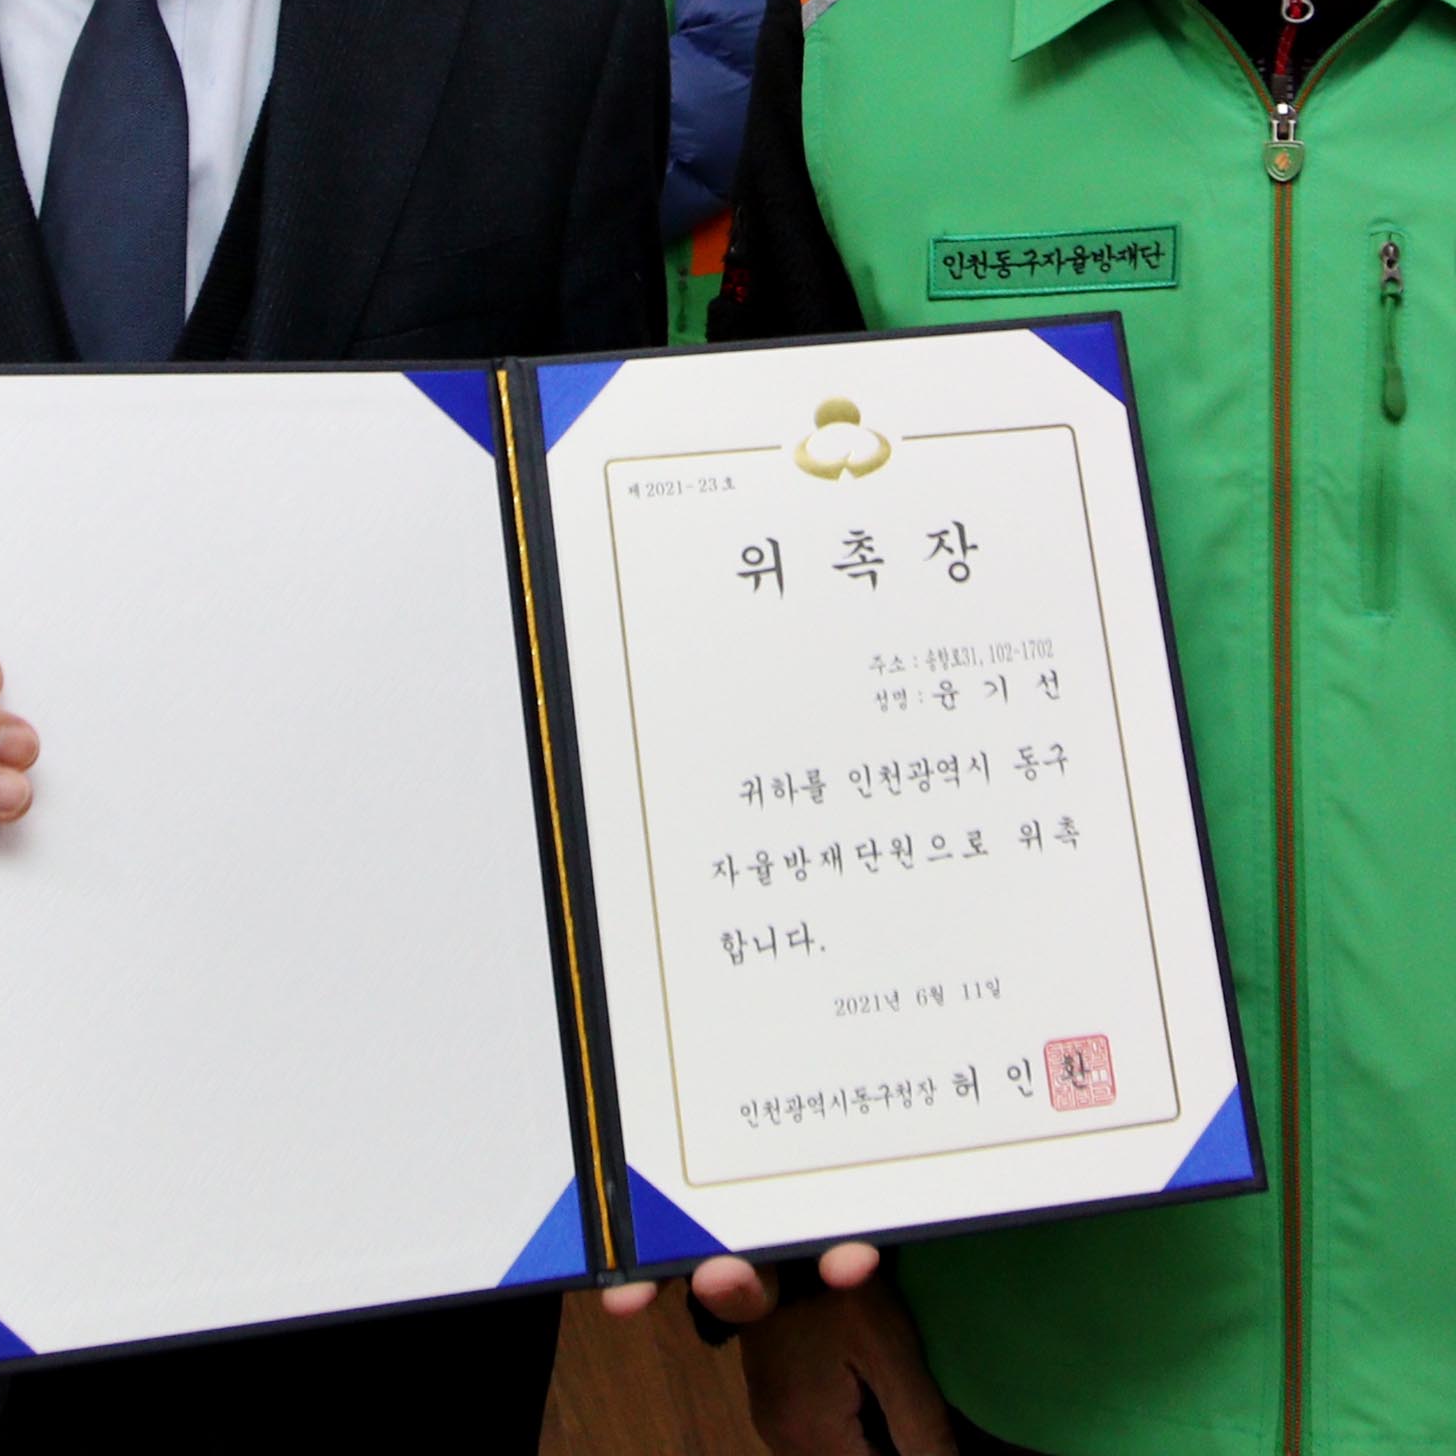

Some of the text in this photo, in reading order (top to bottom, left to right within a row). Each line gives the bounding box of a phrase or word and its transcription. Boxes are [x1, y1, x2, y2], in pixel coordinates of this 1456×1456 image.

[942, 239, 1166, 280] 인천동구자율방재단
[739, 742, 1069, 809] 귀하를 인천광역시 동구
[712, 815, 1081, 887] 자율방재단원으로 위촉
[720, 921, 827, 966] 합니다.
[834, 976, 1001, 1017] 2021년 6월 11일
[739, 1076, 937, 1129] 인천광역시동구청장
